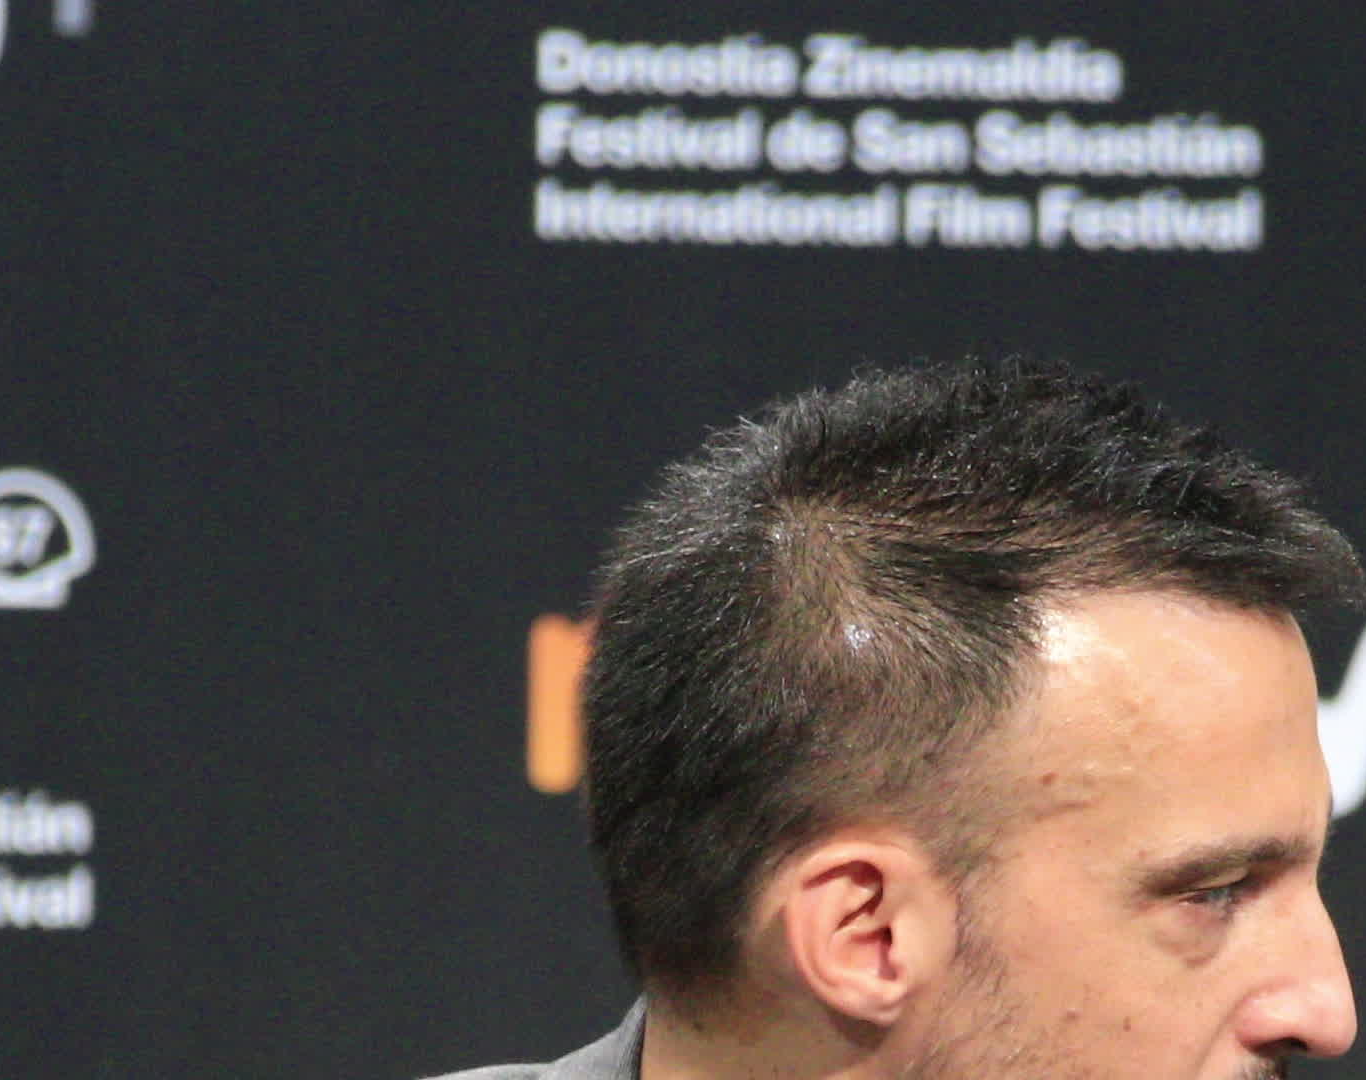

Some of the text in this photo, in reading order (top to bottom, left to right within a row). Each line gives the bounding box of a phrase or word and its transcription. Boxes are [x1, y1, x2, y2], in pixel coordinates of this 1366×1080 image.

[537, 29, 1123, 102] Donostia Zinemaldia
[536, 103, 1262, 177] Festival de San Sebastián
[534, 179, 1262, 251] International Film Festival
